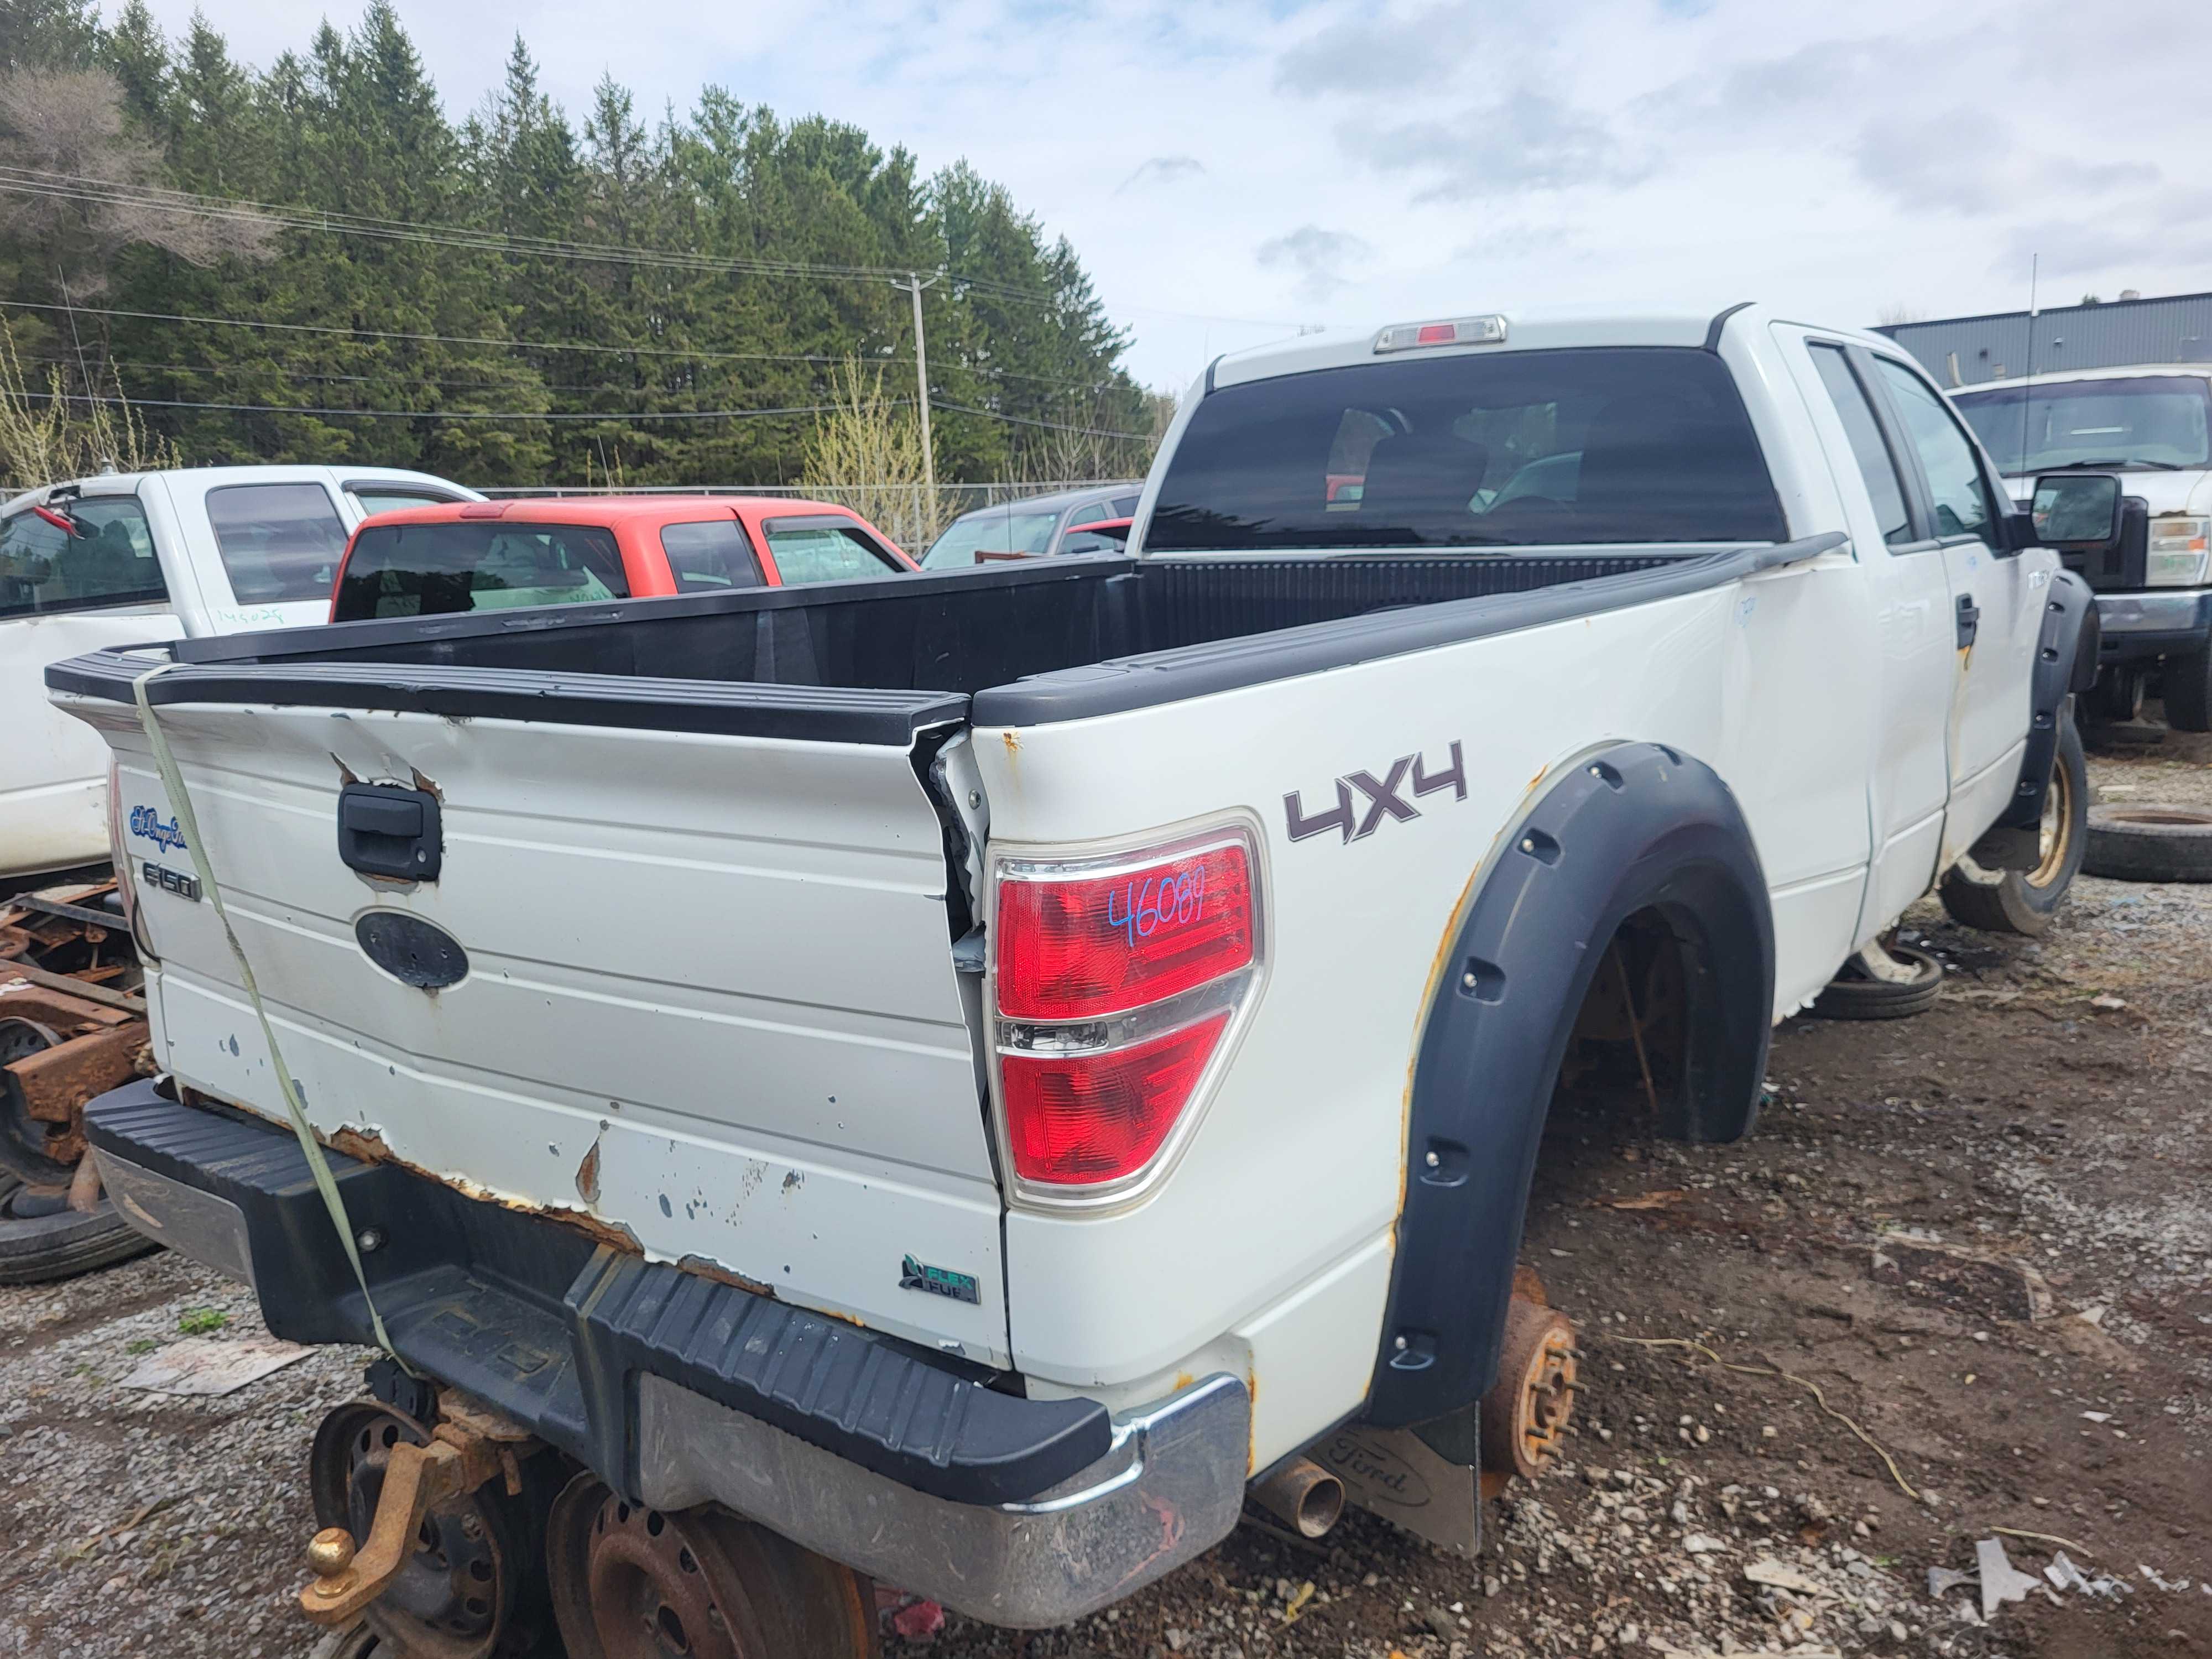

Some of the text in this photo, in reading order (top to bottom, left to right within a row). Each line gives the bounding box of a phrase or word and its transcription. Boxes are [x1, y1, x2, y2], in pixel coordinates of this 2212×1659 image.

[1282, 739, 1467, 844] 4X4
[1108, 865, 1204, 947] 46089
[927, 1267, 973, 1290] FLEX
